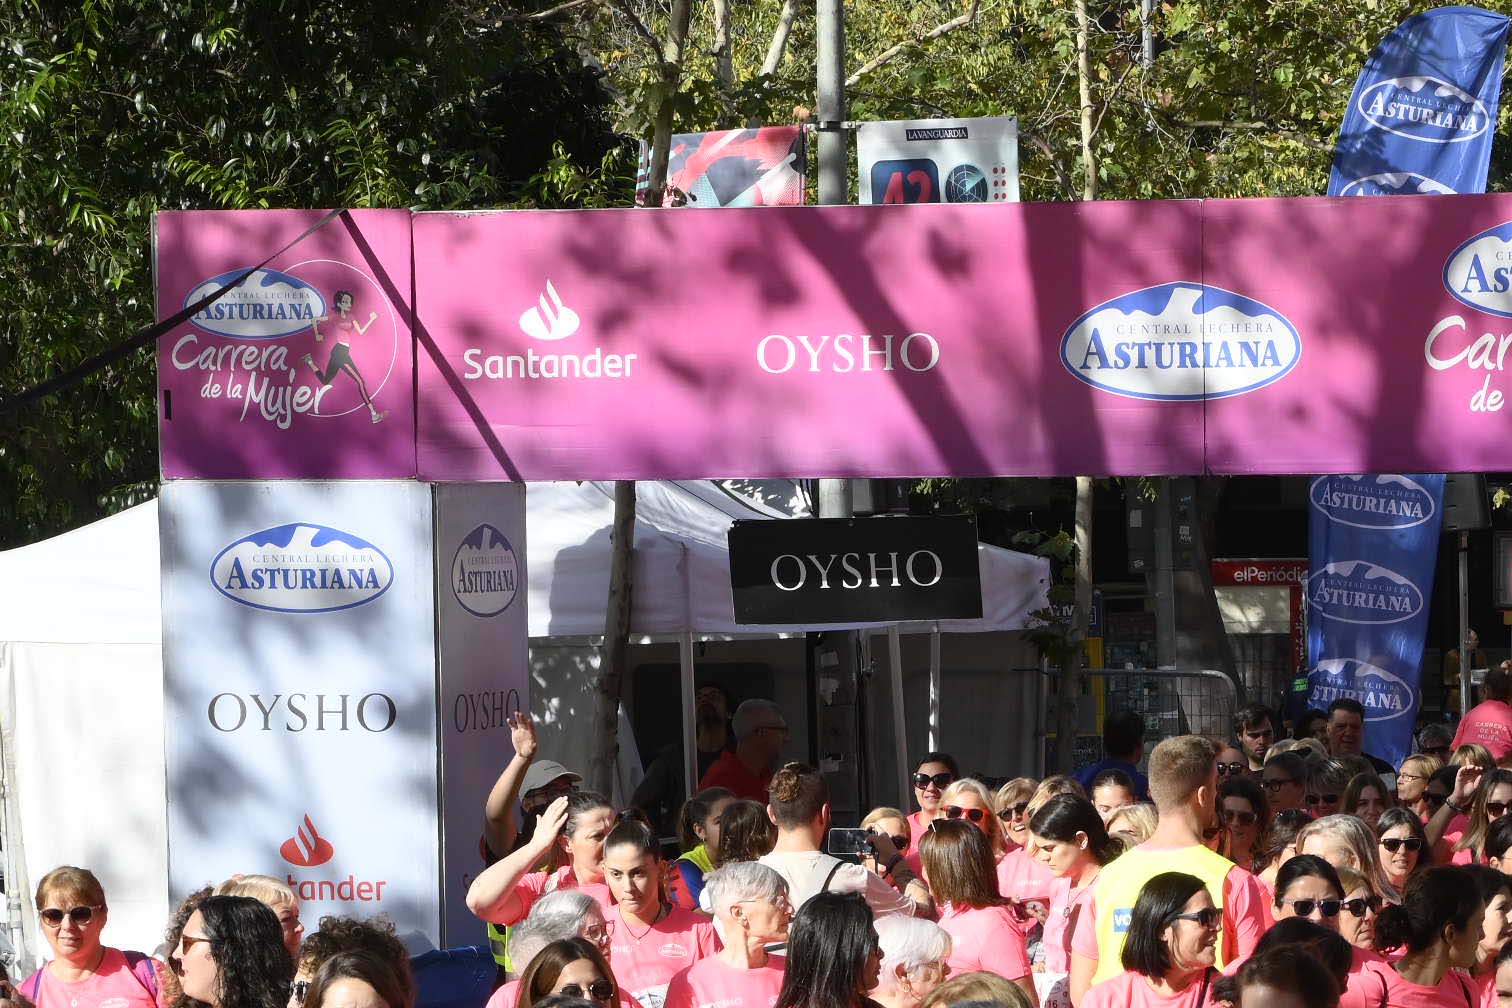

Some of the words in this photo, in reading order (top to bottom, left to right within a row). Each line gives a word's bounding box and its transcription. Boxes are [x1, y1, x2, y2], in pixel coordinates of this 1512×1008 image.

[1367, 91, 1478, 132] ASTURIANA
[1116, 323, 1192, 335] CENTRAL
[1199, 322, 1274, 334] LECHERA
[171, 333, 289, 371] Carrera
[463, 348, 637, 380] Santander
[757, 332, 940, 374] OYSHO
[1079, 327, 1283, 370] ASTURIANA
[201, 373, 223, 399] de
[226, 373, 243, 399] la
[239, 366, 334, 430] Mujer
[1469, 374, 1505, 413] de
[1319, 475, 1424, 519] ASTURIANA
[224, 556, 381, 591] ASTURIANA
[252, 553, 312, 564] CENTRAL
[315, 552, 374, 564] LECHERA
[456, 558, 516, 595] ASTURIANA
[769, 549, 943, 592] OYSHO
[1313, 577, 1413, 613] ASTURIANA
[207, 692, 398, 734] OYSHO
[287, 875, 387, 902] tander
